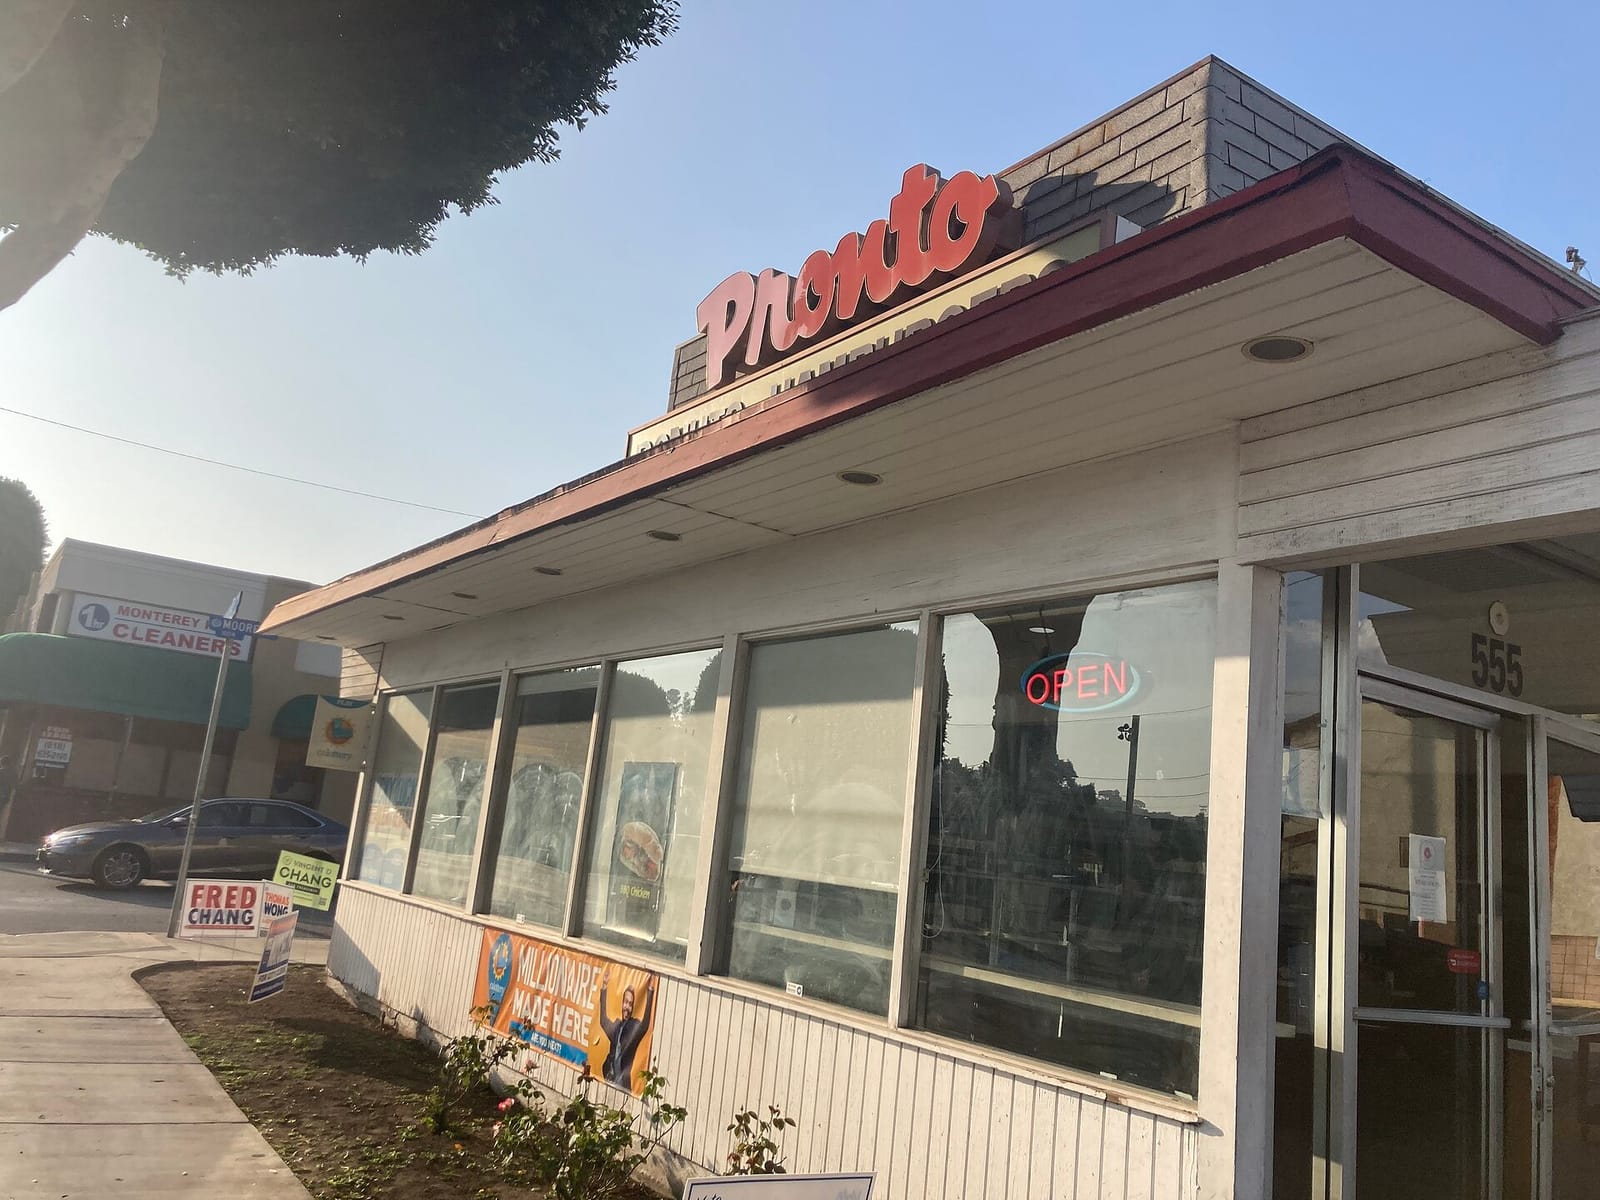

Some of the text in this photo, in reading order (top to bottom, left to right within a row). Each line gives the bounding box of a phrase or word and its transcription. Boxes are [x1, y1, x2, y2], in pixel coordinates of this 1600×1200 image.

[696, 163, 1000, 391] Pronto
[117, 605, 201, 629] MONTEREY
[112, 623, 242, 656] CLEANERS
[1470, 632, 1524, 698] 555
[1025, 660, 1128, 705] OPEN
[279, 866, 332, 888] CHANG
[294, 860, 325, 873] VINCENT
[190, 884, 257, 909] FRED
[264, 902, 289, 916] WONG
[265, 892, 290, 906] THOMAS
[188, 908, 254, 926] CHANG
[516, 944, 602, 1011] MILLIONAIRE
[511, 987, 593, 1047] MADE HERE
